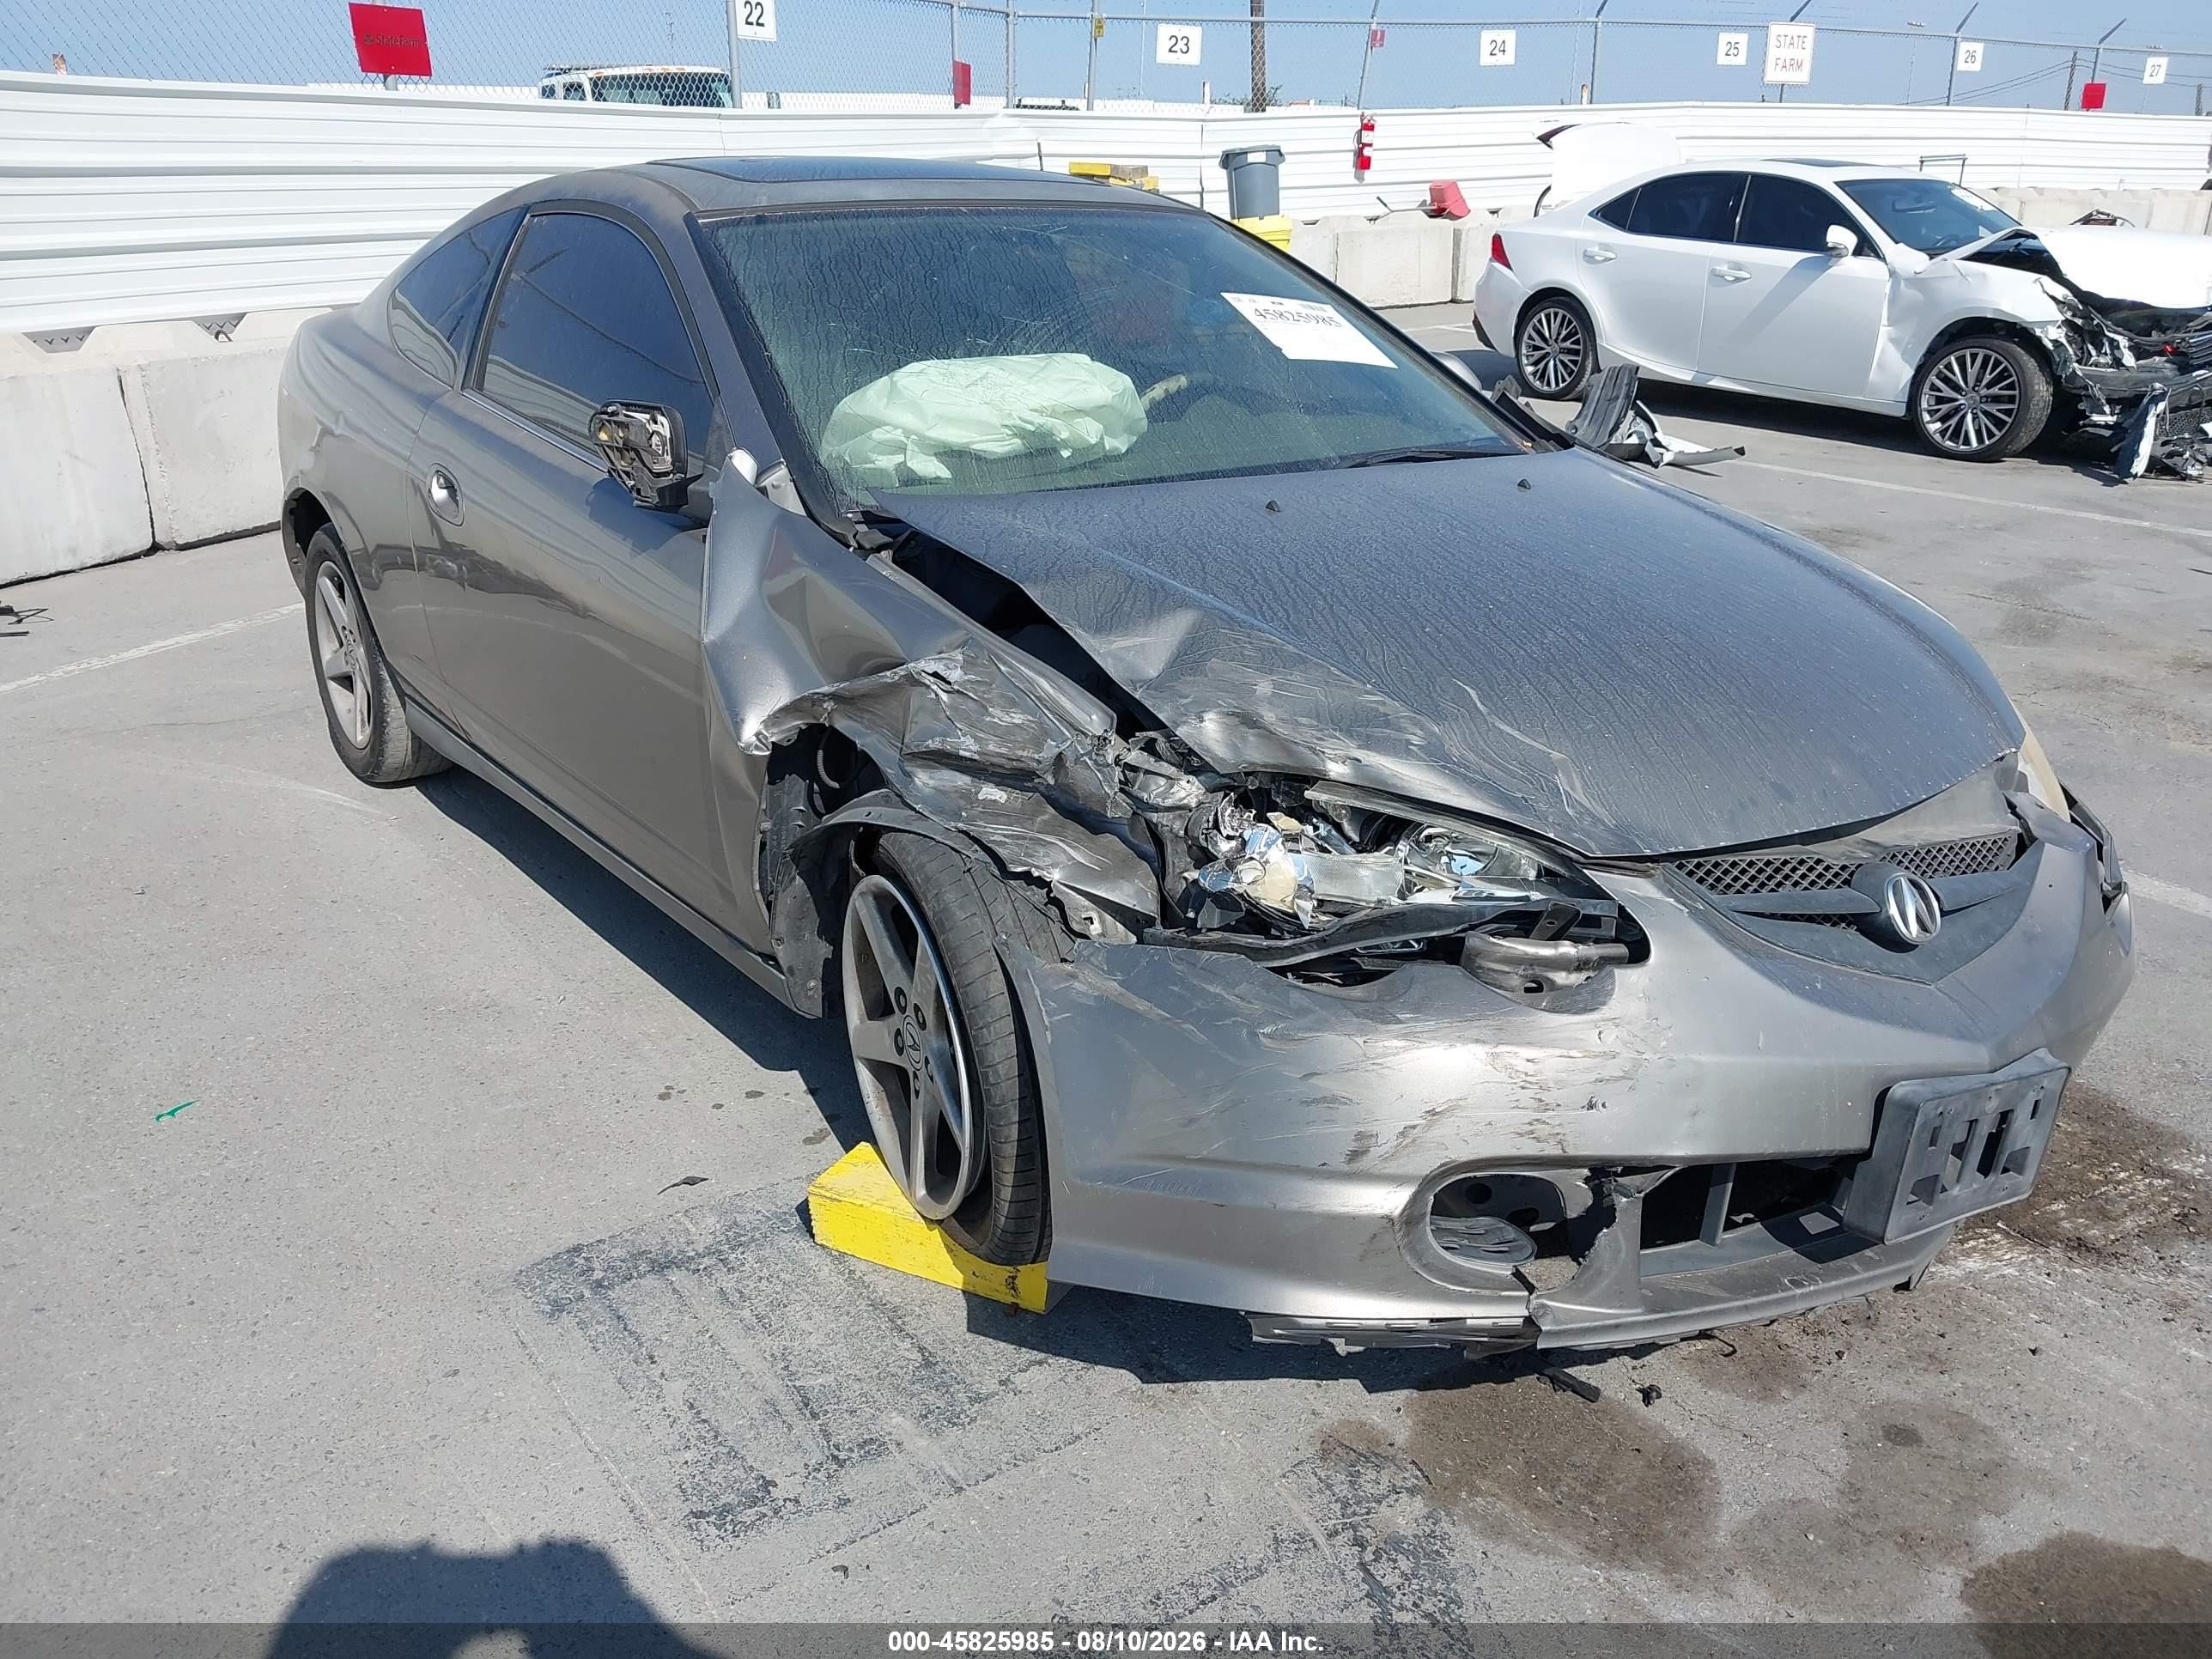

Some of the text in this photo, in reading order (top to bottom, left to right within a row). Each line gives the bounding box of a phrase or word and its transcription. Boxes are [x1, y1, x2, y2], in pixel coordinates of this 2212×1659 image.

[744, 0, 765, 27] 22
[1168, 34, 1190, 54] 23
[1489, 39, 1506, 57] 24
[1724, 40, 1740, 57] 25
[1774, 34, 1808, 50] STATE
[1964, 49, 1977, 64] 26
[1774, 58, 1804, 73] FARM
[2149, 64, 2162, 78] 27
